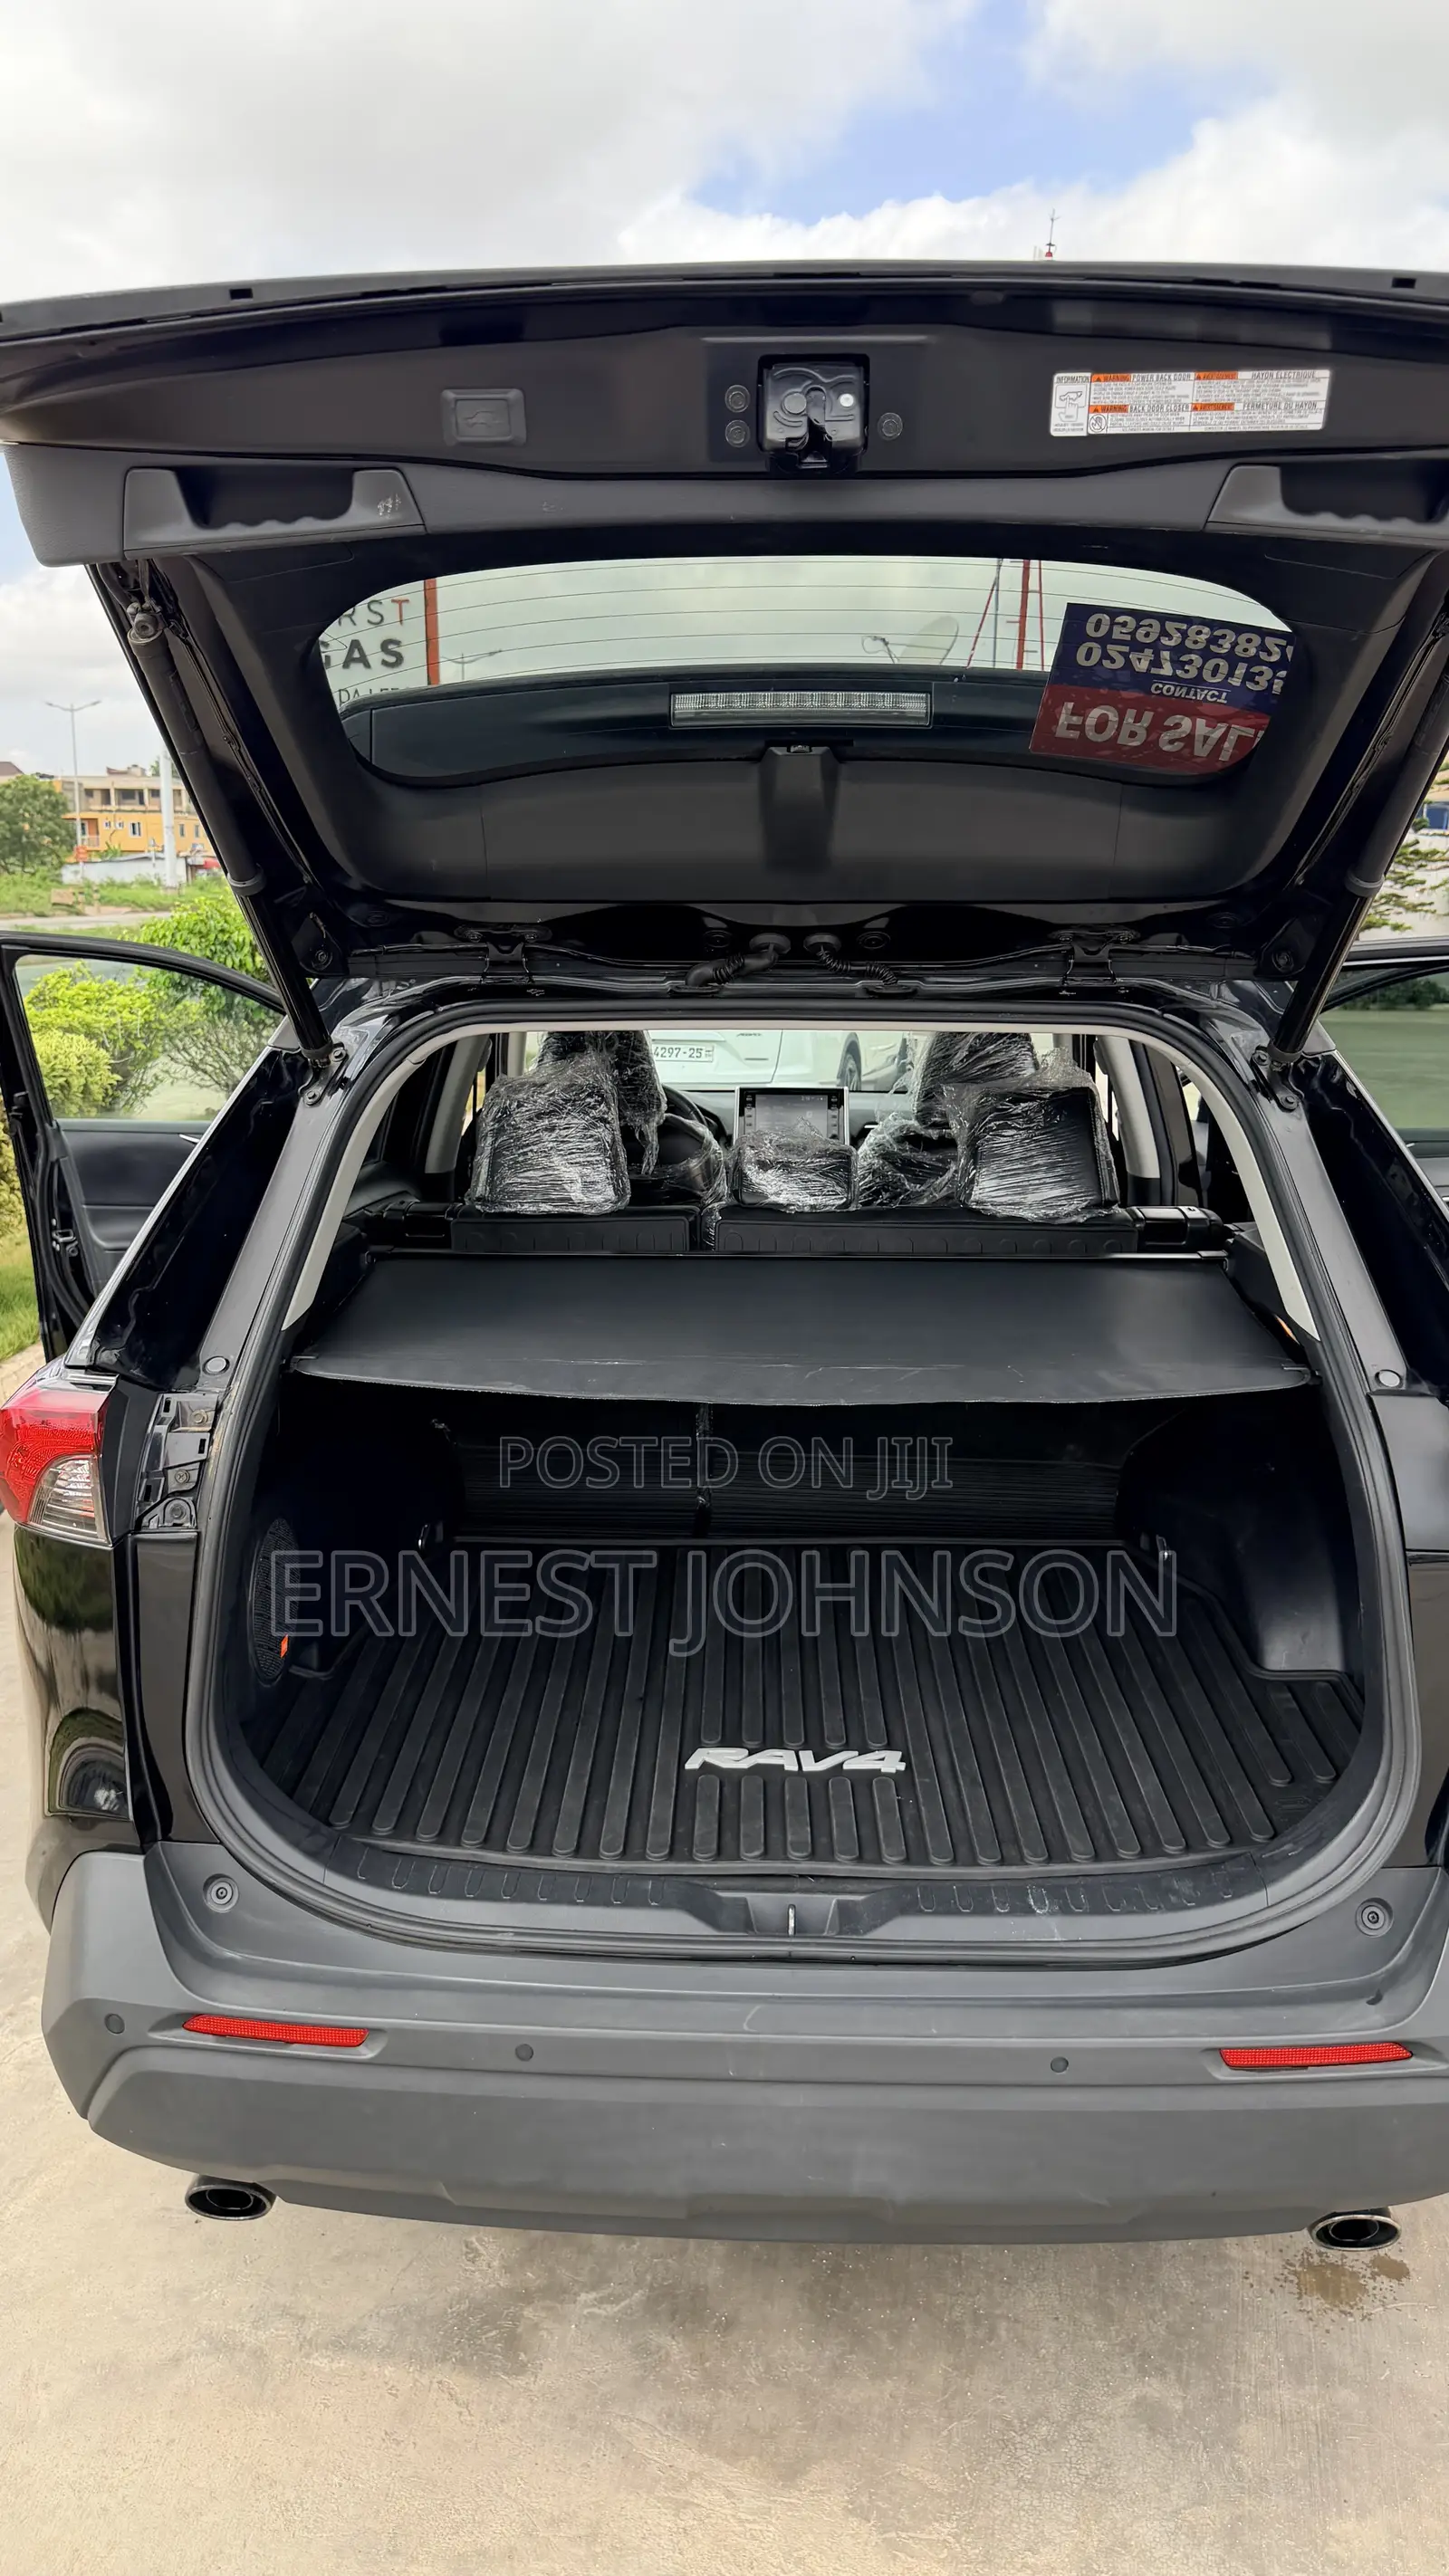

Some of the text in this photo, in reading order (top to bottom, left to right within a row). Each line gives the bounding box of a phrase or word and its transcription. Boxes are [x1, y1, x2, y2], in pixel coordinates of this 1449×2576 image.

[1132, 374, 1155, 382] POWER
[1156, 373, 1172, 381] BACK
[1173, 373, 1191, 381] DOOR
[1252, 371, 1274, 380] HAYON
[1129, 405, 1146, 413] BACK
[1147, 404, 1165, 413] DOOR
[1166, 404, 1190, 412] CLOSER
[1295, 400, 1318, 410] HAYON
[685, 1747, 907, 1773] RAV4
